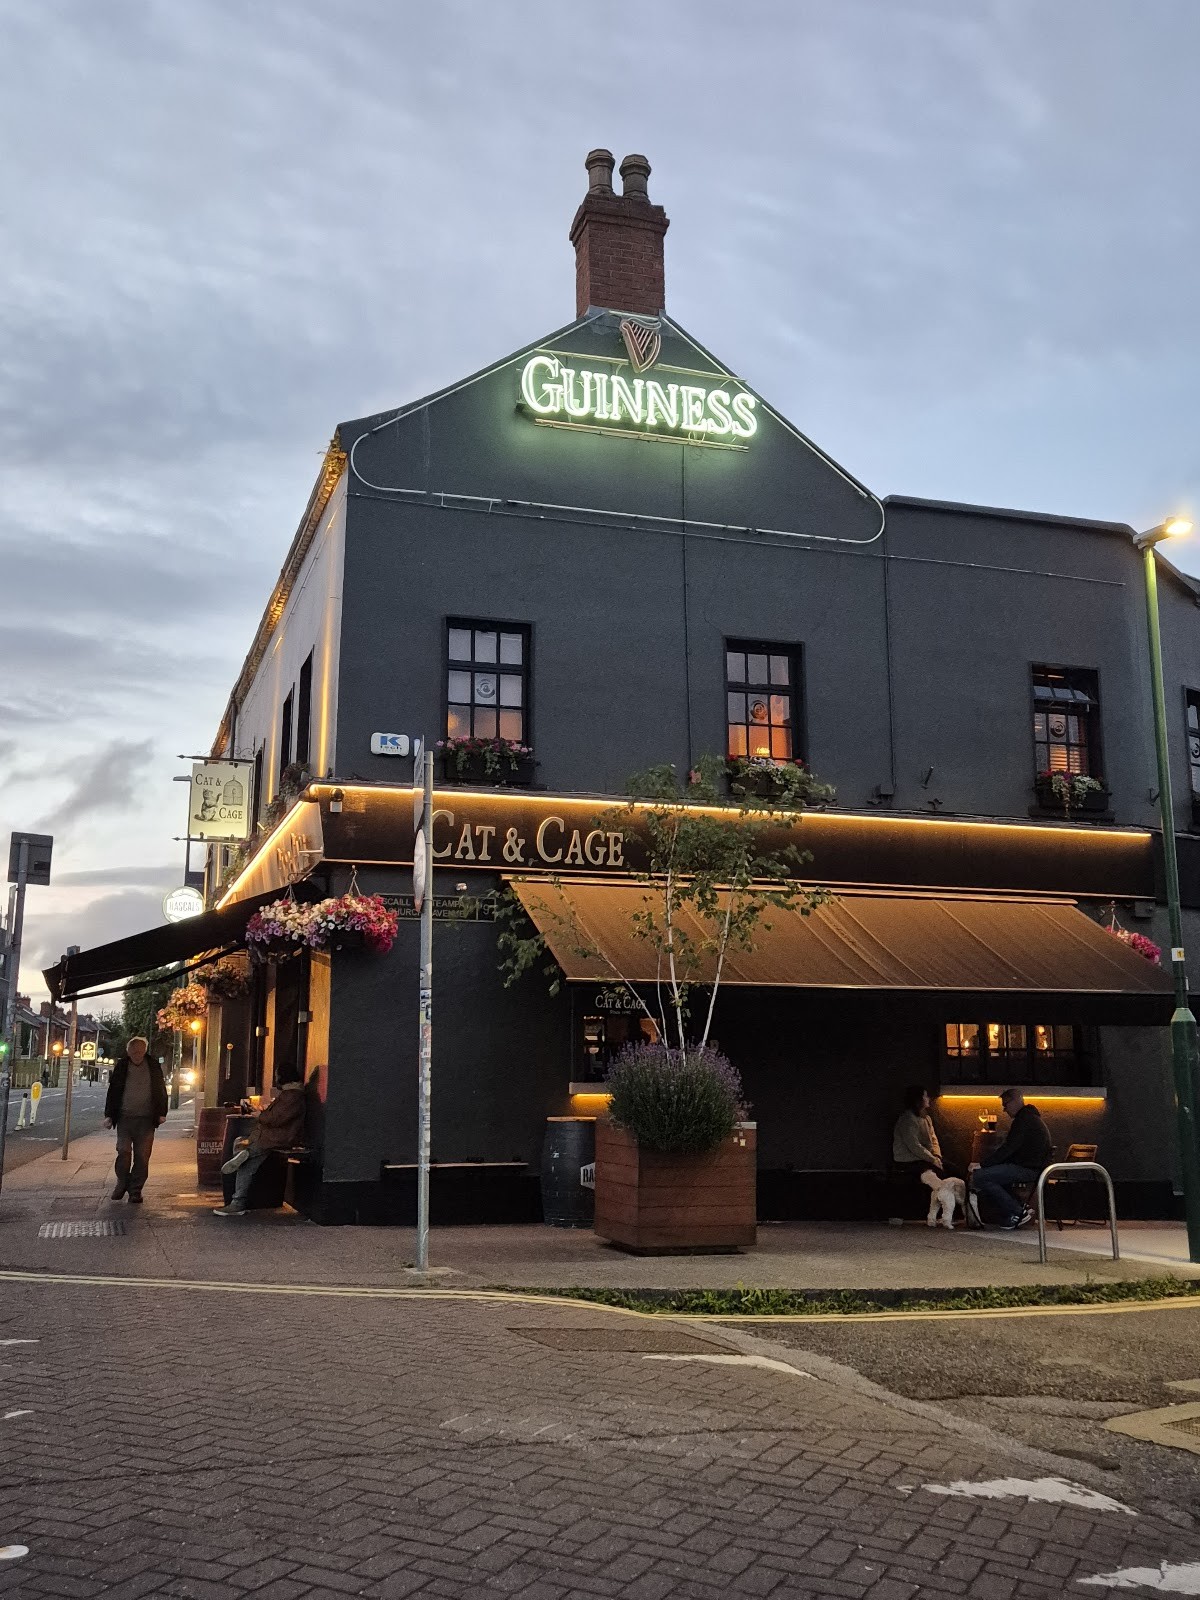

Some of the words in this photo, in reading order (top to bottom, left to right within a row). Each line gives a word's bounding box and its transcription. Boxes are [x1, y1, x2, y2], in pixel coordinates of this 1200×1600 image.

[521, 356, 757, 437] GUINNESS
[195, 773, 213, 785] CAT
[215, 778, 222, 786] &
[219, 807, 243, 819] CAGE
[432, 810, 496, 861] CAT
[502, 827, 526, 863] &
[536, 816, 625, 867] CAGE
[382, 897, 411, 906] SCAILL
[595, 994, 613, 1009] CAT
[615, 998, 622, 1009] &
